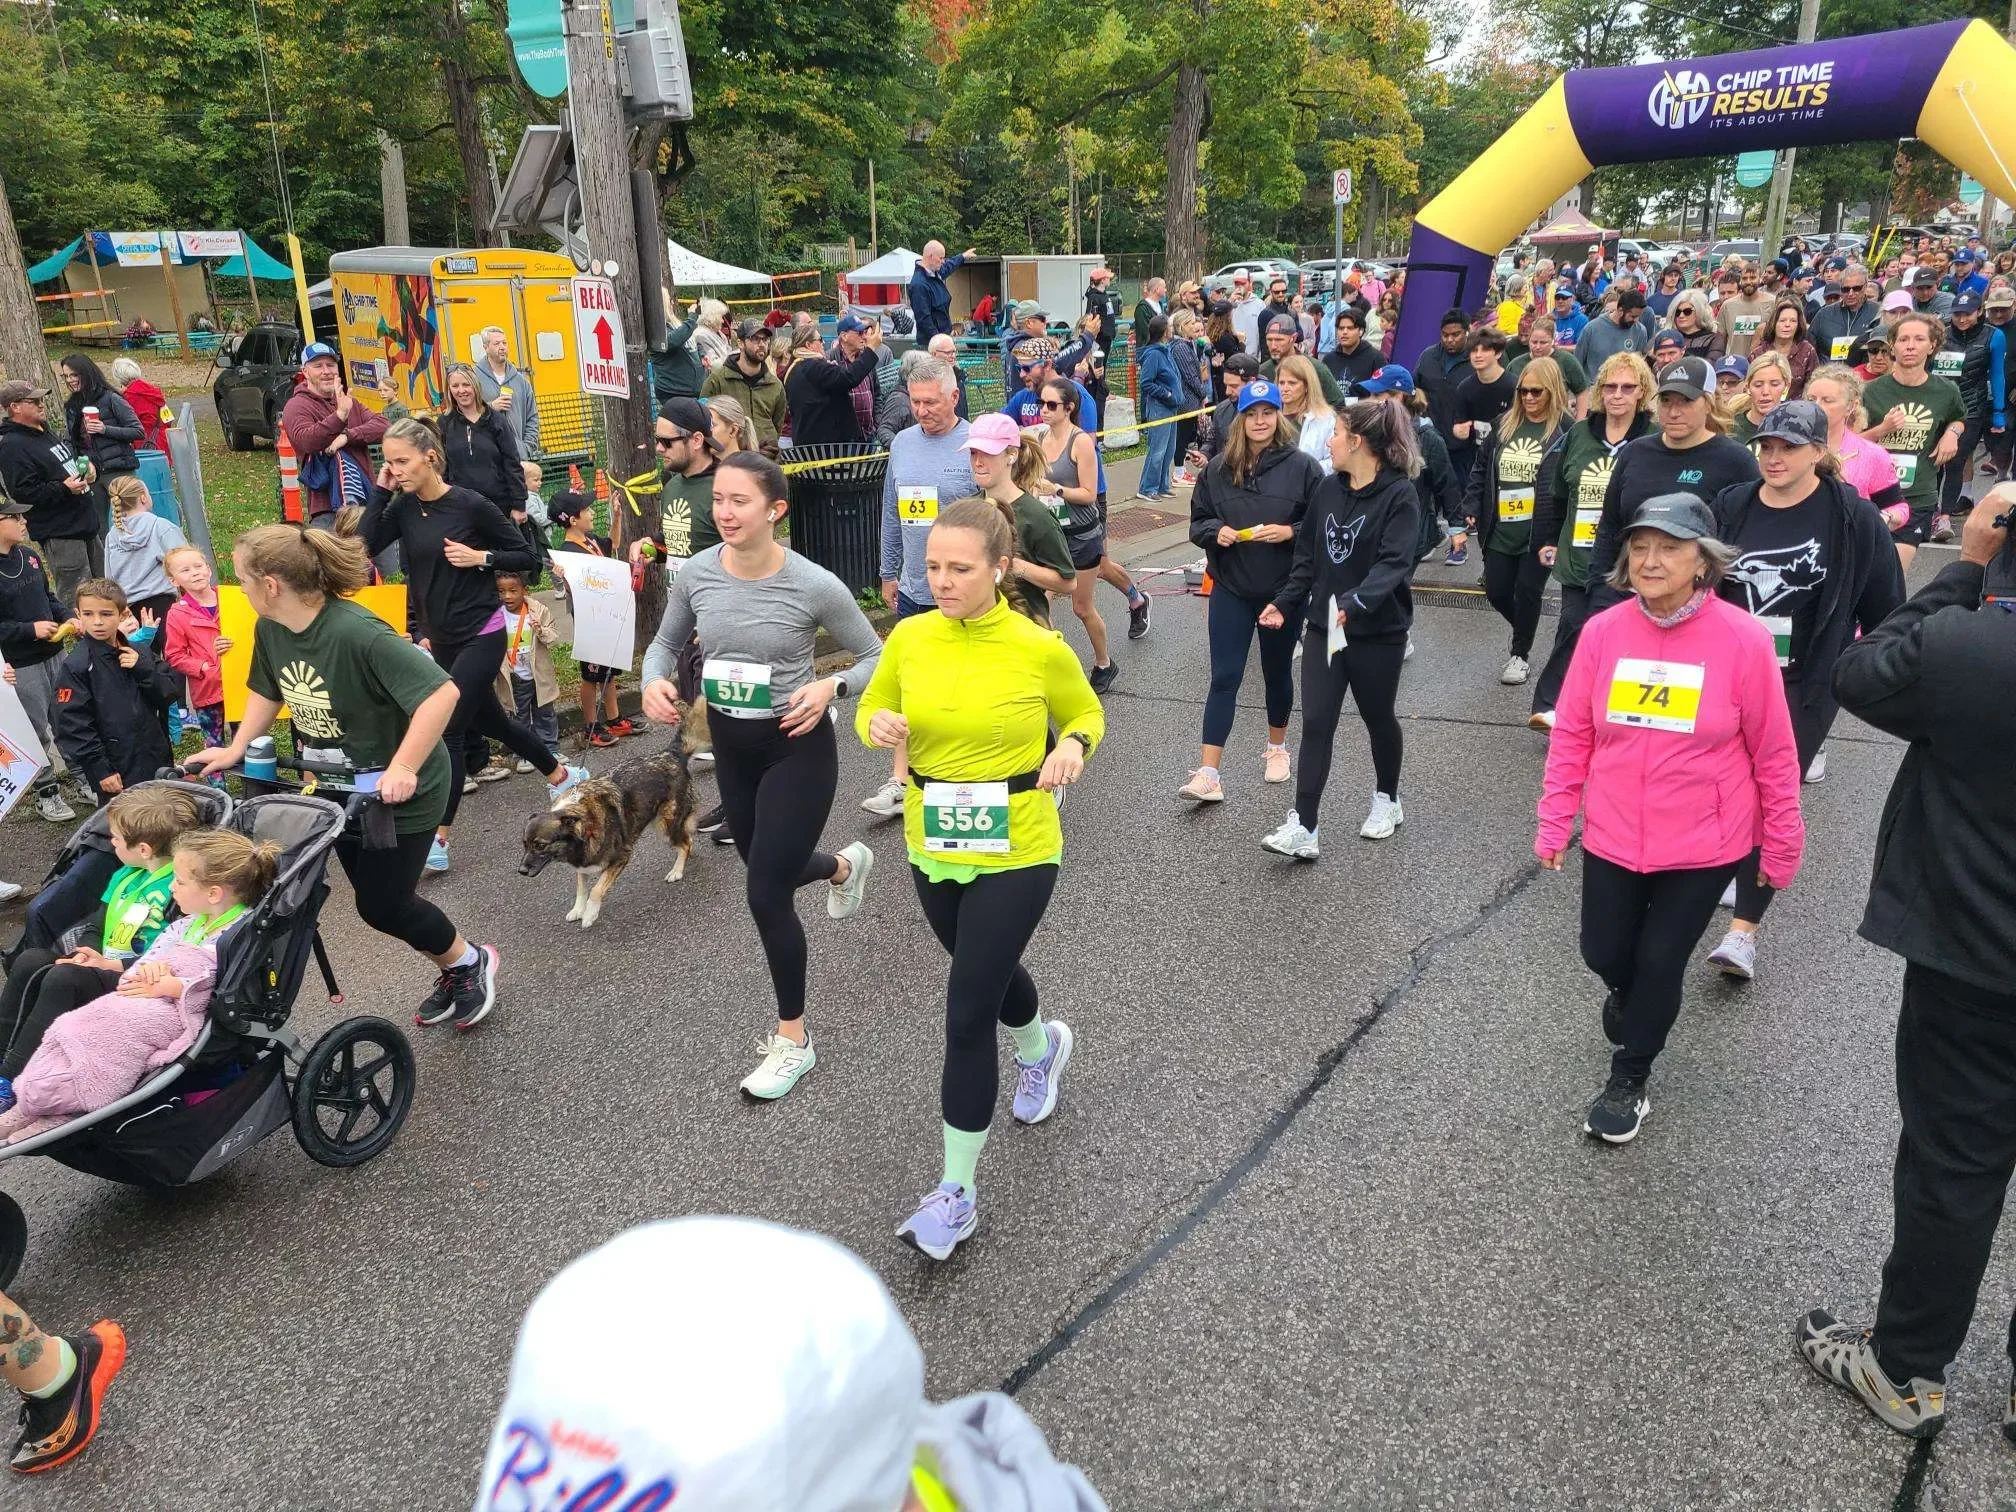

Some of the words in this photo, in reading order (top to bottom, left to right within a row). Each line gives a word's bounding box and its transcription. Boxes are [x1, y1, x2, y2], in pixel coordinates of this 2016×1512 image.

[1716, 69, 1772, 93] CHIP
[1776, 61, 1835, 85] TIME
[1712, 82, 1831, 115] RESULTS
[1709, 118, 1733, 129] IT'S
[1738, 113, 1785, 127] ABOUT
[1791, 108, 1825, 121] TIME
[1937, 360, 1957, 369] 502
[586, 363, 626, 388] PARKING
[1499, 459, 1539, 472] CRYSTAL
[1522, 470, 1539, 483] 5K
[909, 500, 926, 514] 63
[1508, 500, 1524, 512] 54
[677, 540, 692, 556] 5K
[717, 680, 755, 703] 517
[1638, 683, 1669, 708] 74
[316, 718, 345, 739] 5K
[937, 807, 994, 832] 556
